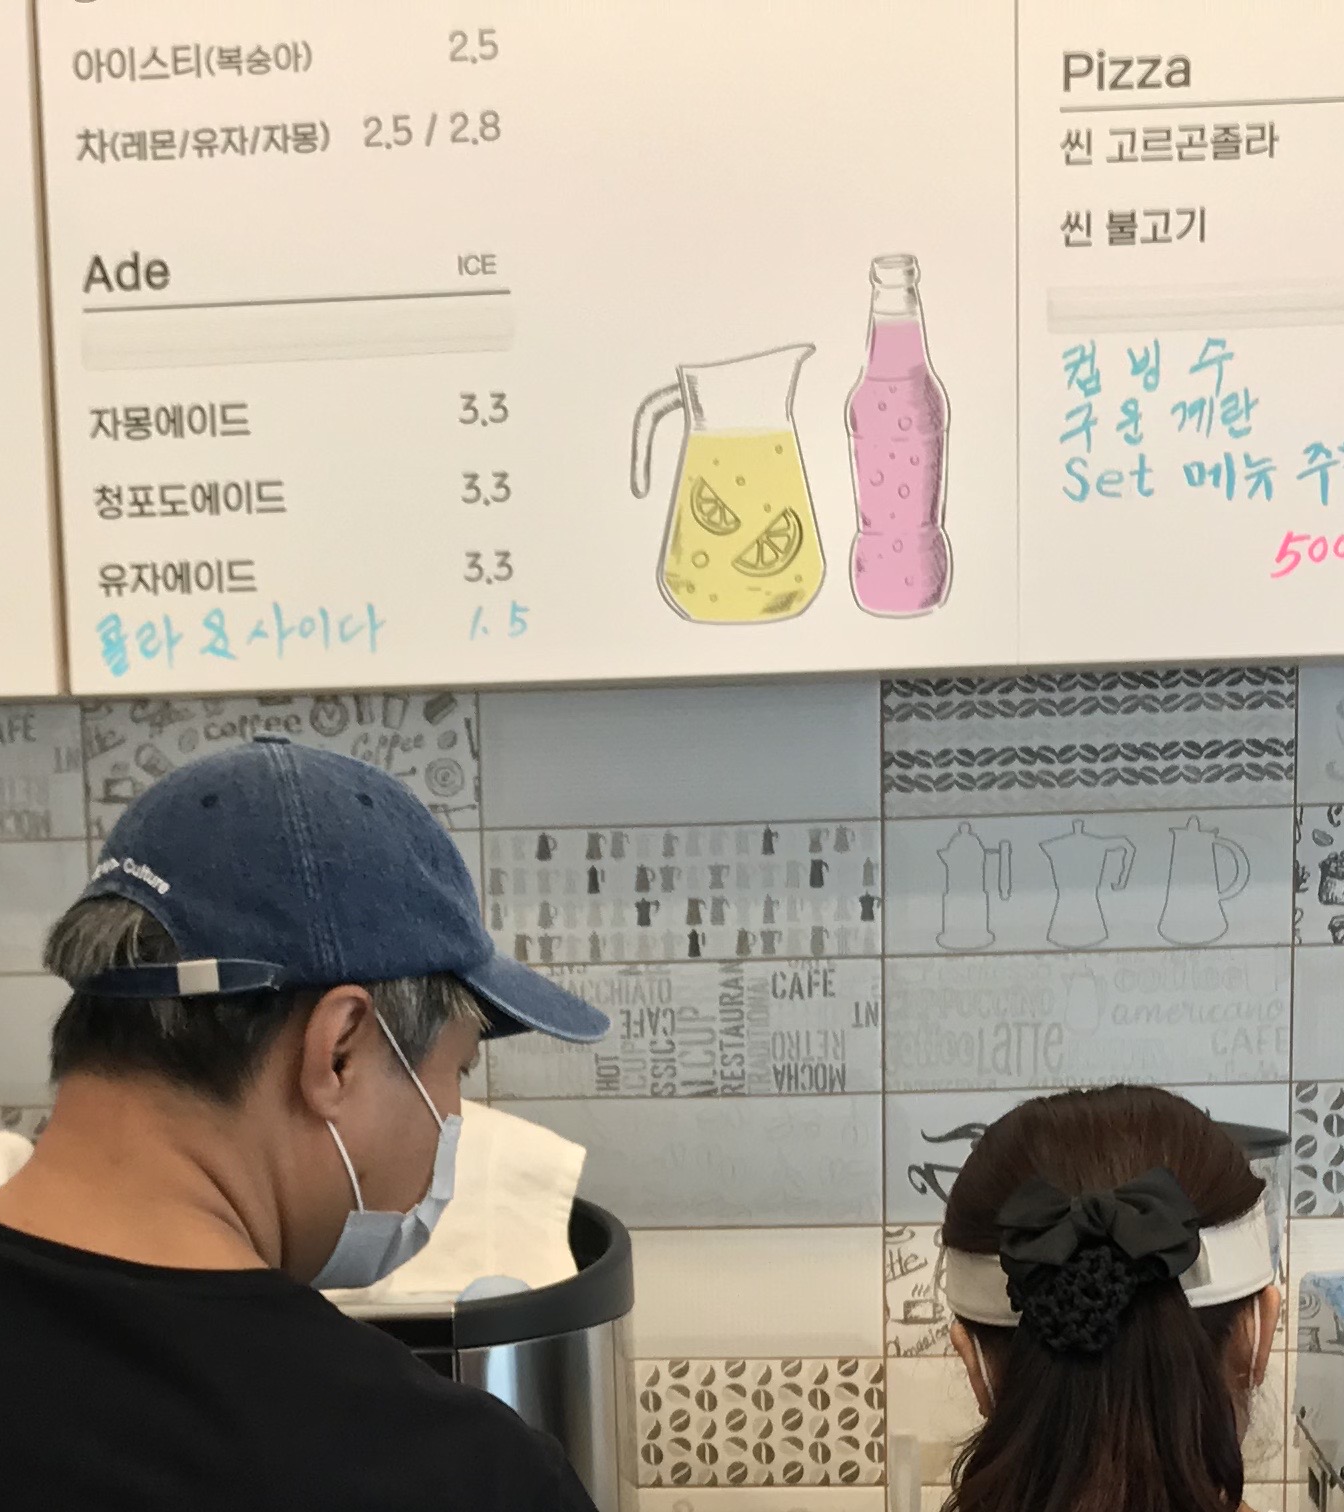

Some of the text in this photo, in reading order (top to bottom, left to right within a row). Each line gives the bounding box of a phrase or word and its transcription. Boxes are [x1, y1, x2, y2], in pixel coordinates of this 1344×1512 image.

[73, 29, 498, 83] 아이스티(복숭아) 2.5
[1064, 51, 1190, 92] Pizza
[364, 115, 413, 149] 2.5
[450, 110, 501, 145] 2.8
[1061, 130, 1092, 165] 씬
[1107, 123, 1278, 163] 고르곤졸라
[1061, 212, 1091, 247] 씬
[1107, 207, 1205, 246] 불고기
[84, 252, 496, 293] Ade ICE
[91, 393, 508, 440] 자몽에이드 3.3
[95, 471, 511, 519] 청포도에이드 3.3
[1062, 452, 1156, 503] Set
[100, 551, 513, 596] 유자에이드 3.3
[770, 968, 837, 1000] CAFE
[619, 1007, 676, 1040] CAFE
